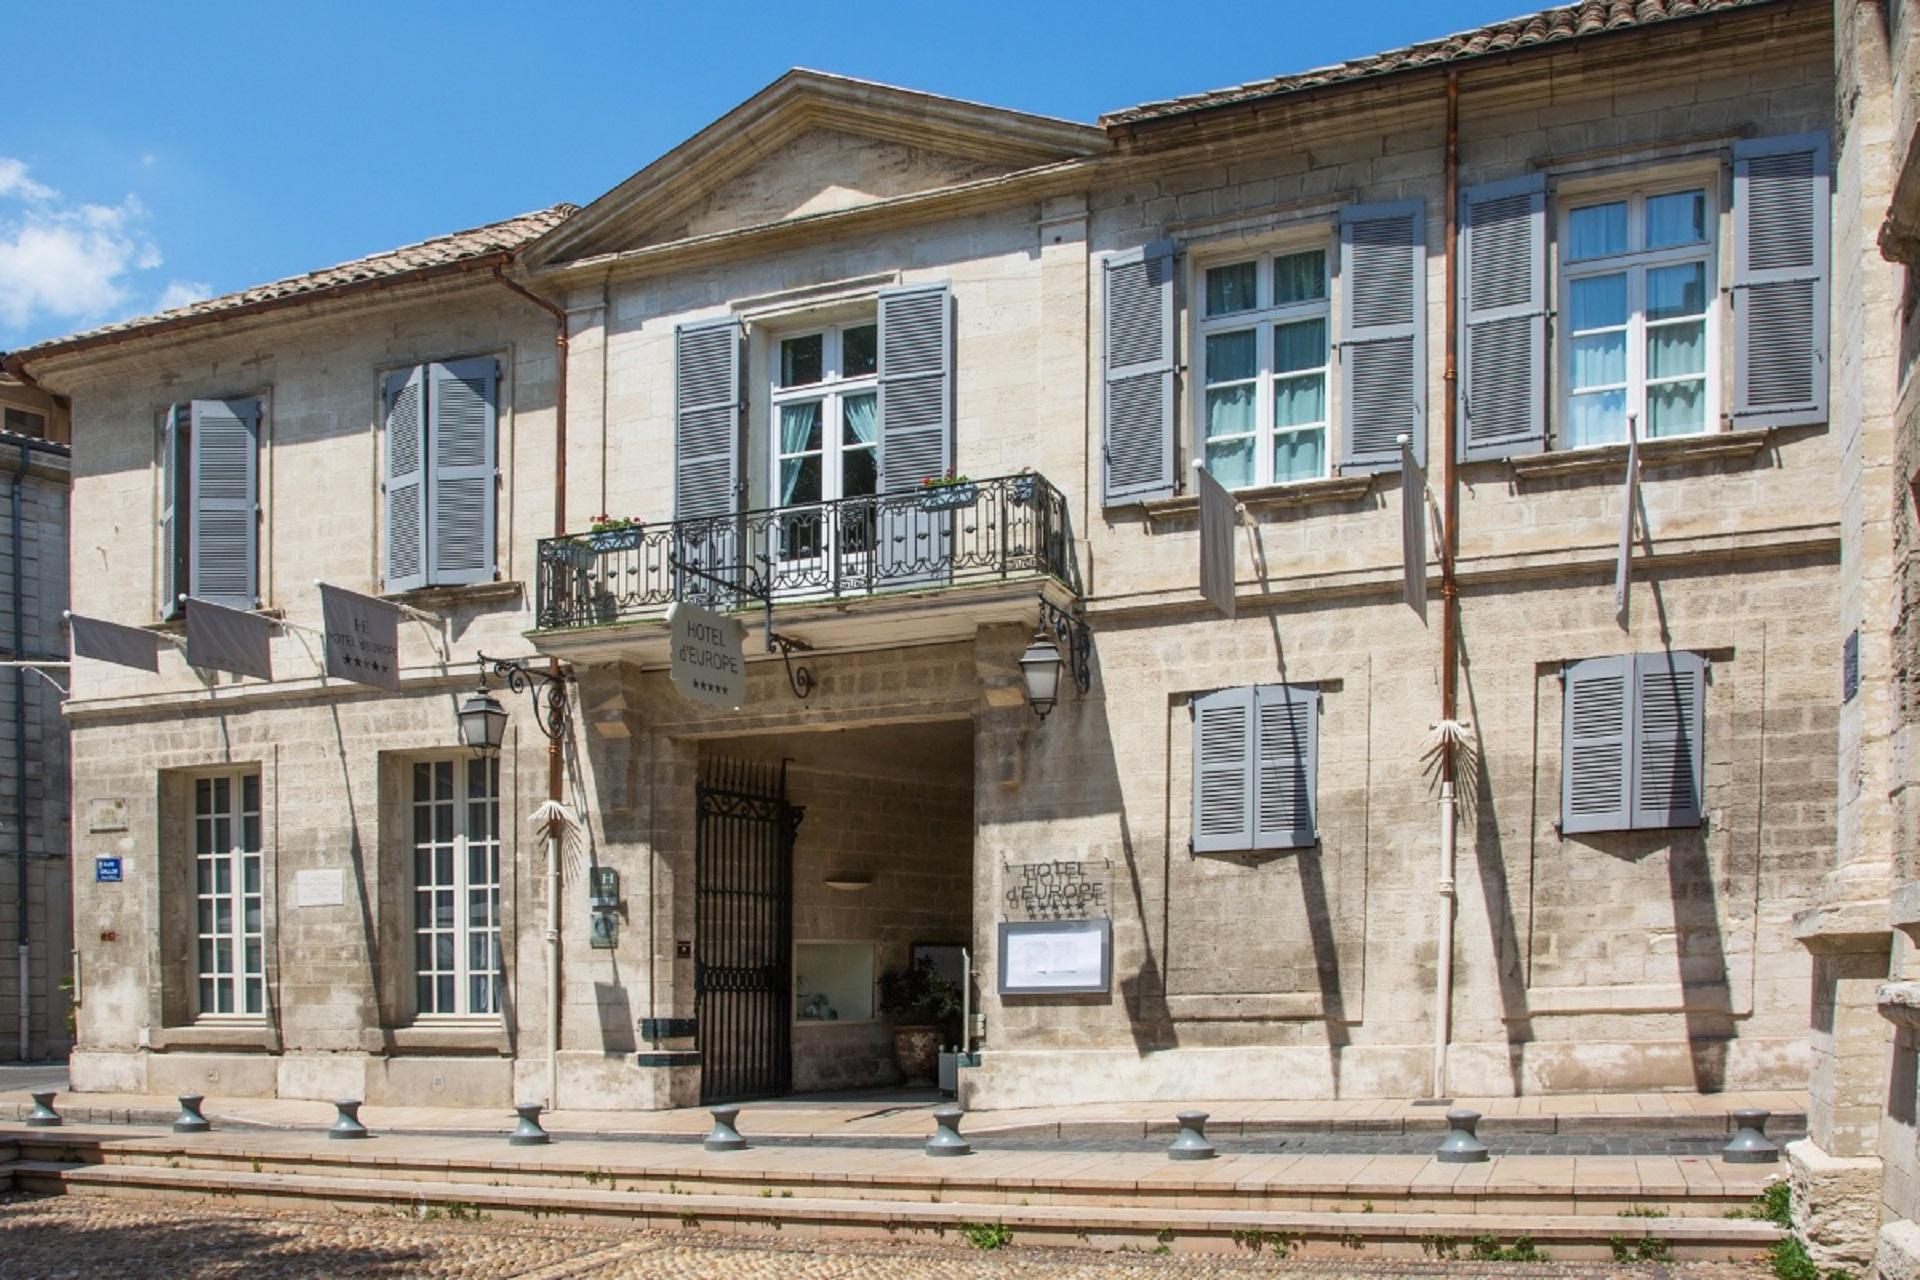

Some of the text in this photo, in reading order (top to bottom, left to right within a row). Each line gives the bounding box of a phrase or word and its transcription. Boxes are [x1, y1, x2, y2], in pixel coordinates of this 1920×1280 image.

[687, 620, 727, 648] HOTEL
[679, 644, 739, 675] d'EUROPE
[602, 873, 614, 884] H
[1023, 860, 1087, 878] HOTEL
[1006, 882, 1104, 901] d'EUROPE
